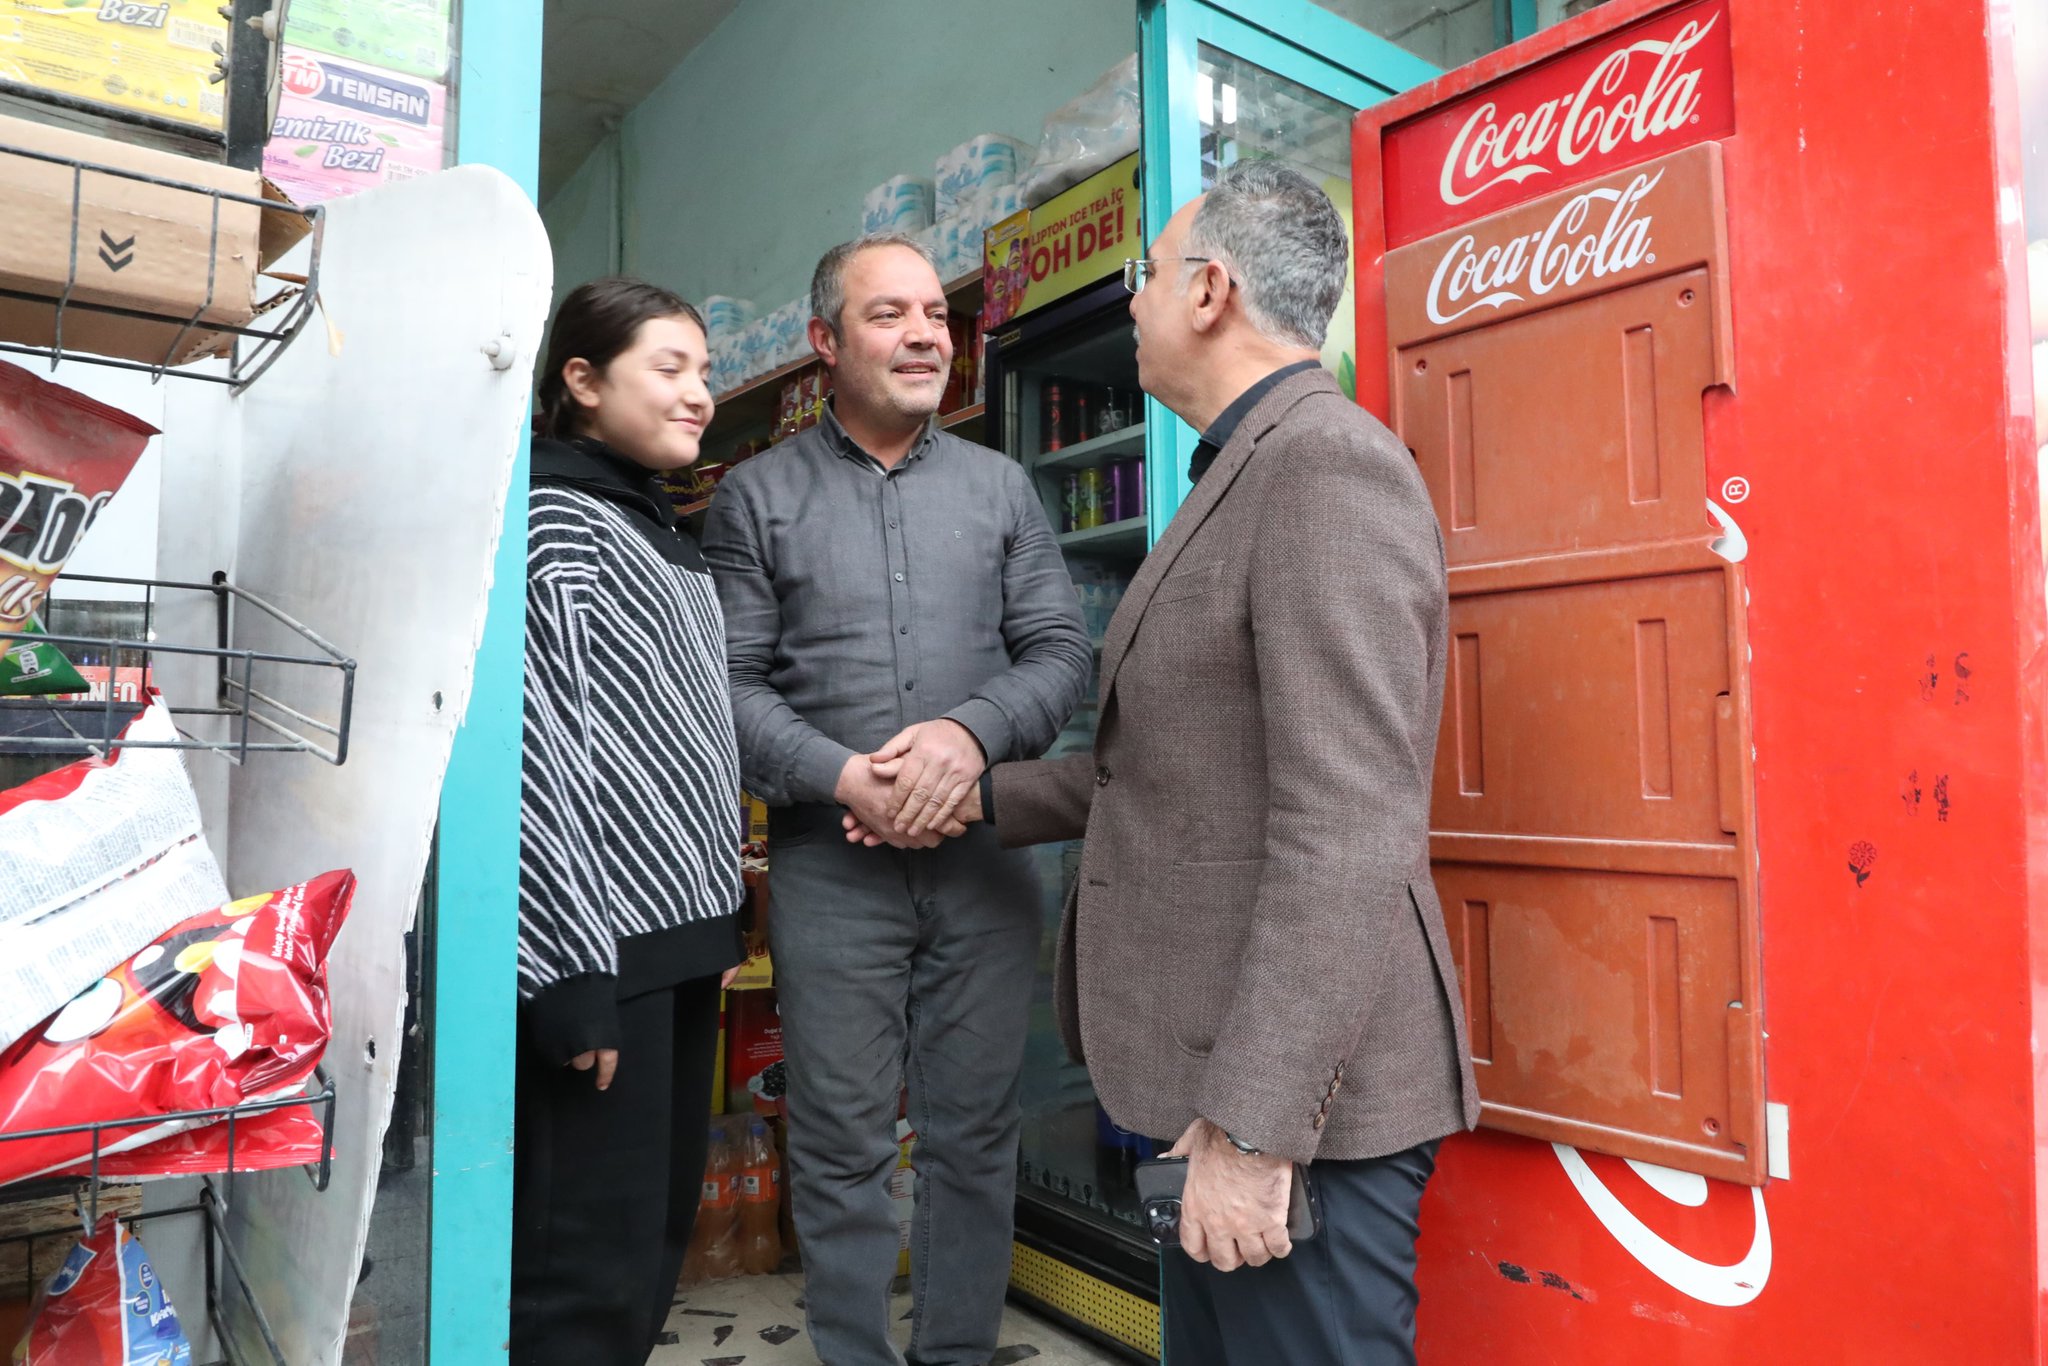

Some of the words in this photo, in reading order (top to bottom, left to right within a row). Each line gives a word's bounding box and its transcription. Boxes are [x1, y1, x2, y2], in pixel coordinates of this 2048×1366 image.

[97, 0, 169, 29] Bezi
[326, 74, 426, 118] TEMSAN
[1439, 9, 1721, 206] Coca-Cola
[271, 115, 371, 145] emizlik
[322, 144, 385, 173] Bezi
[1030, 233, 1071, 282] OH
[1077, 206, 1124, 262] DE!
[1031, 219, 1067, 246] LIPTON
[1069, 208, 1088, 227] ICE
[1089, 198, 1109, 216] TEA
[1425, 166, 1666, 325] Coca-Cola
